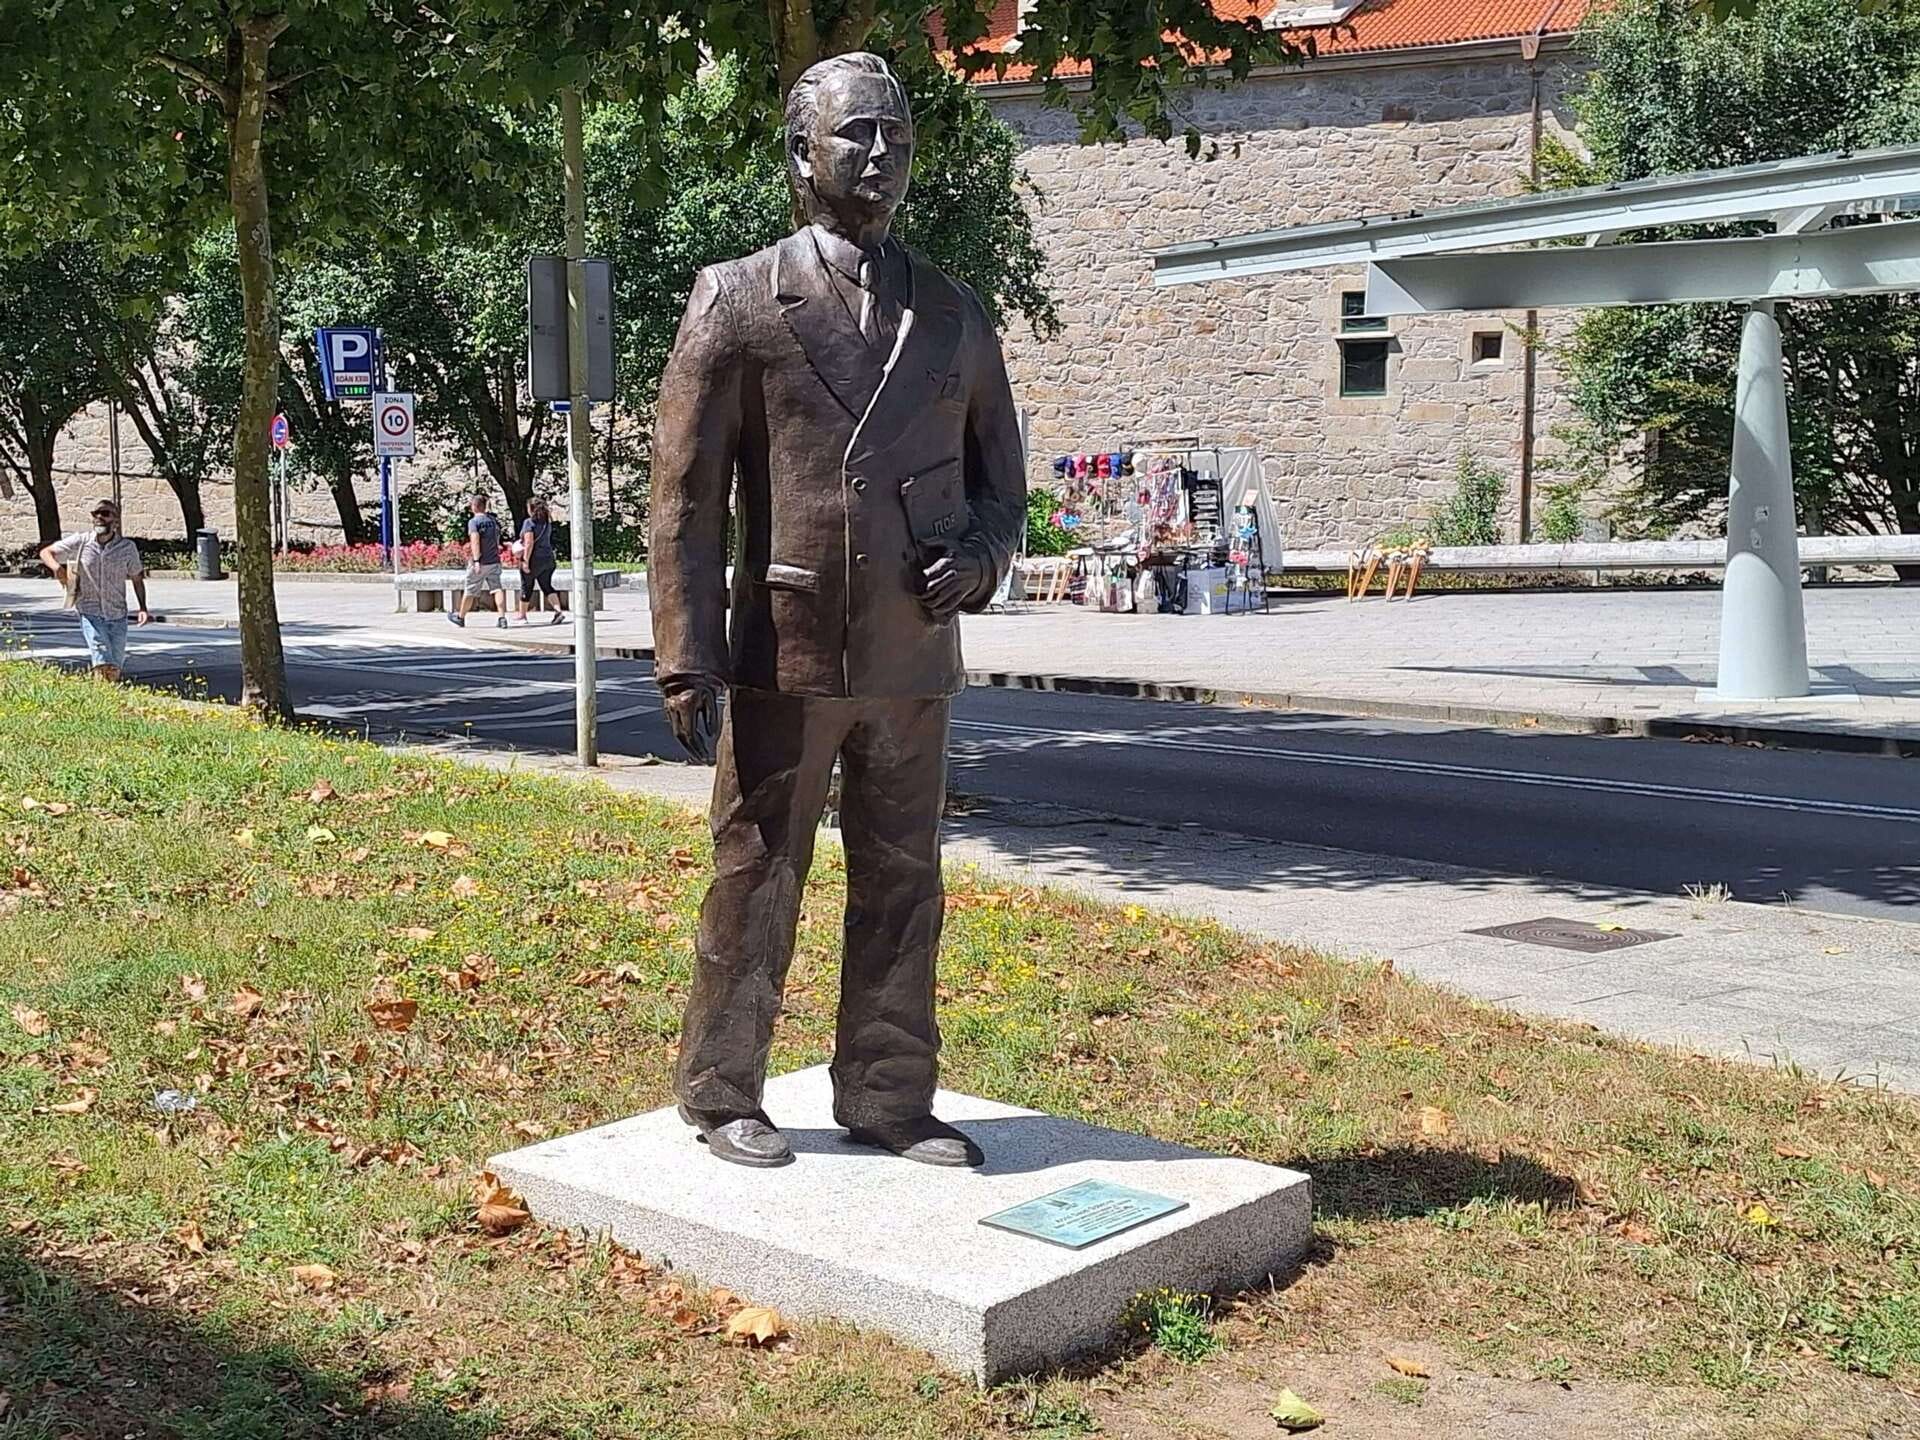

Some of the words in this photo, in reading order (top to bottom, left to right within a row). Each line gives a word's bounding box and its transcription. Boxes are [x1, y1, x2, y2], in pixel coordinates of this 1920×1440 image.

[331, 334, 369, 371] P
[384, 396, 405, 404] ZONA
[387, 415, 404, 427] 10
